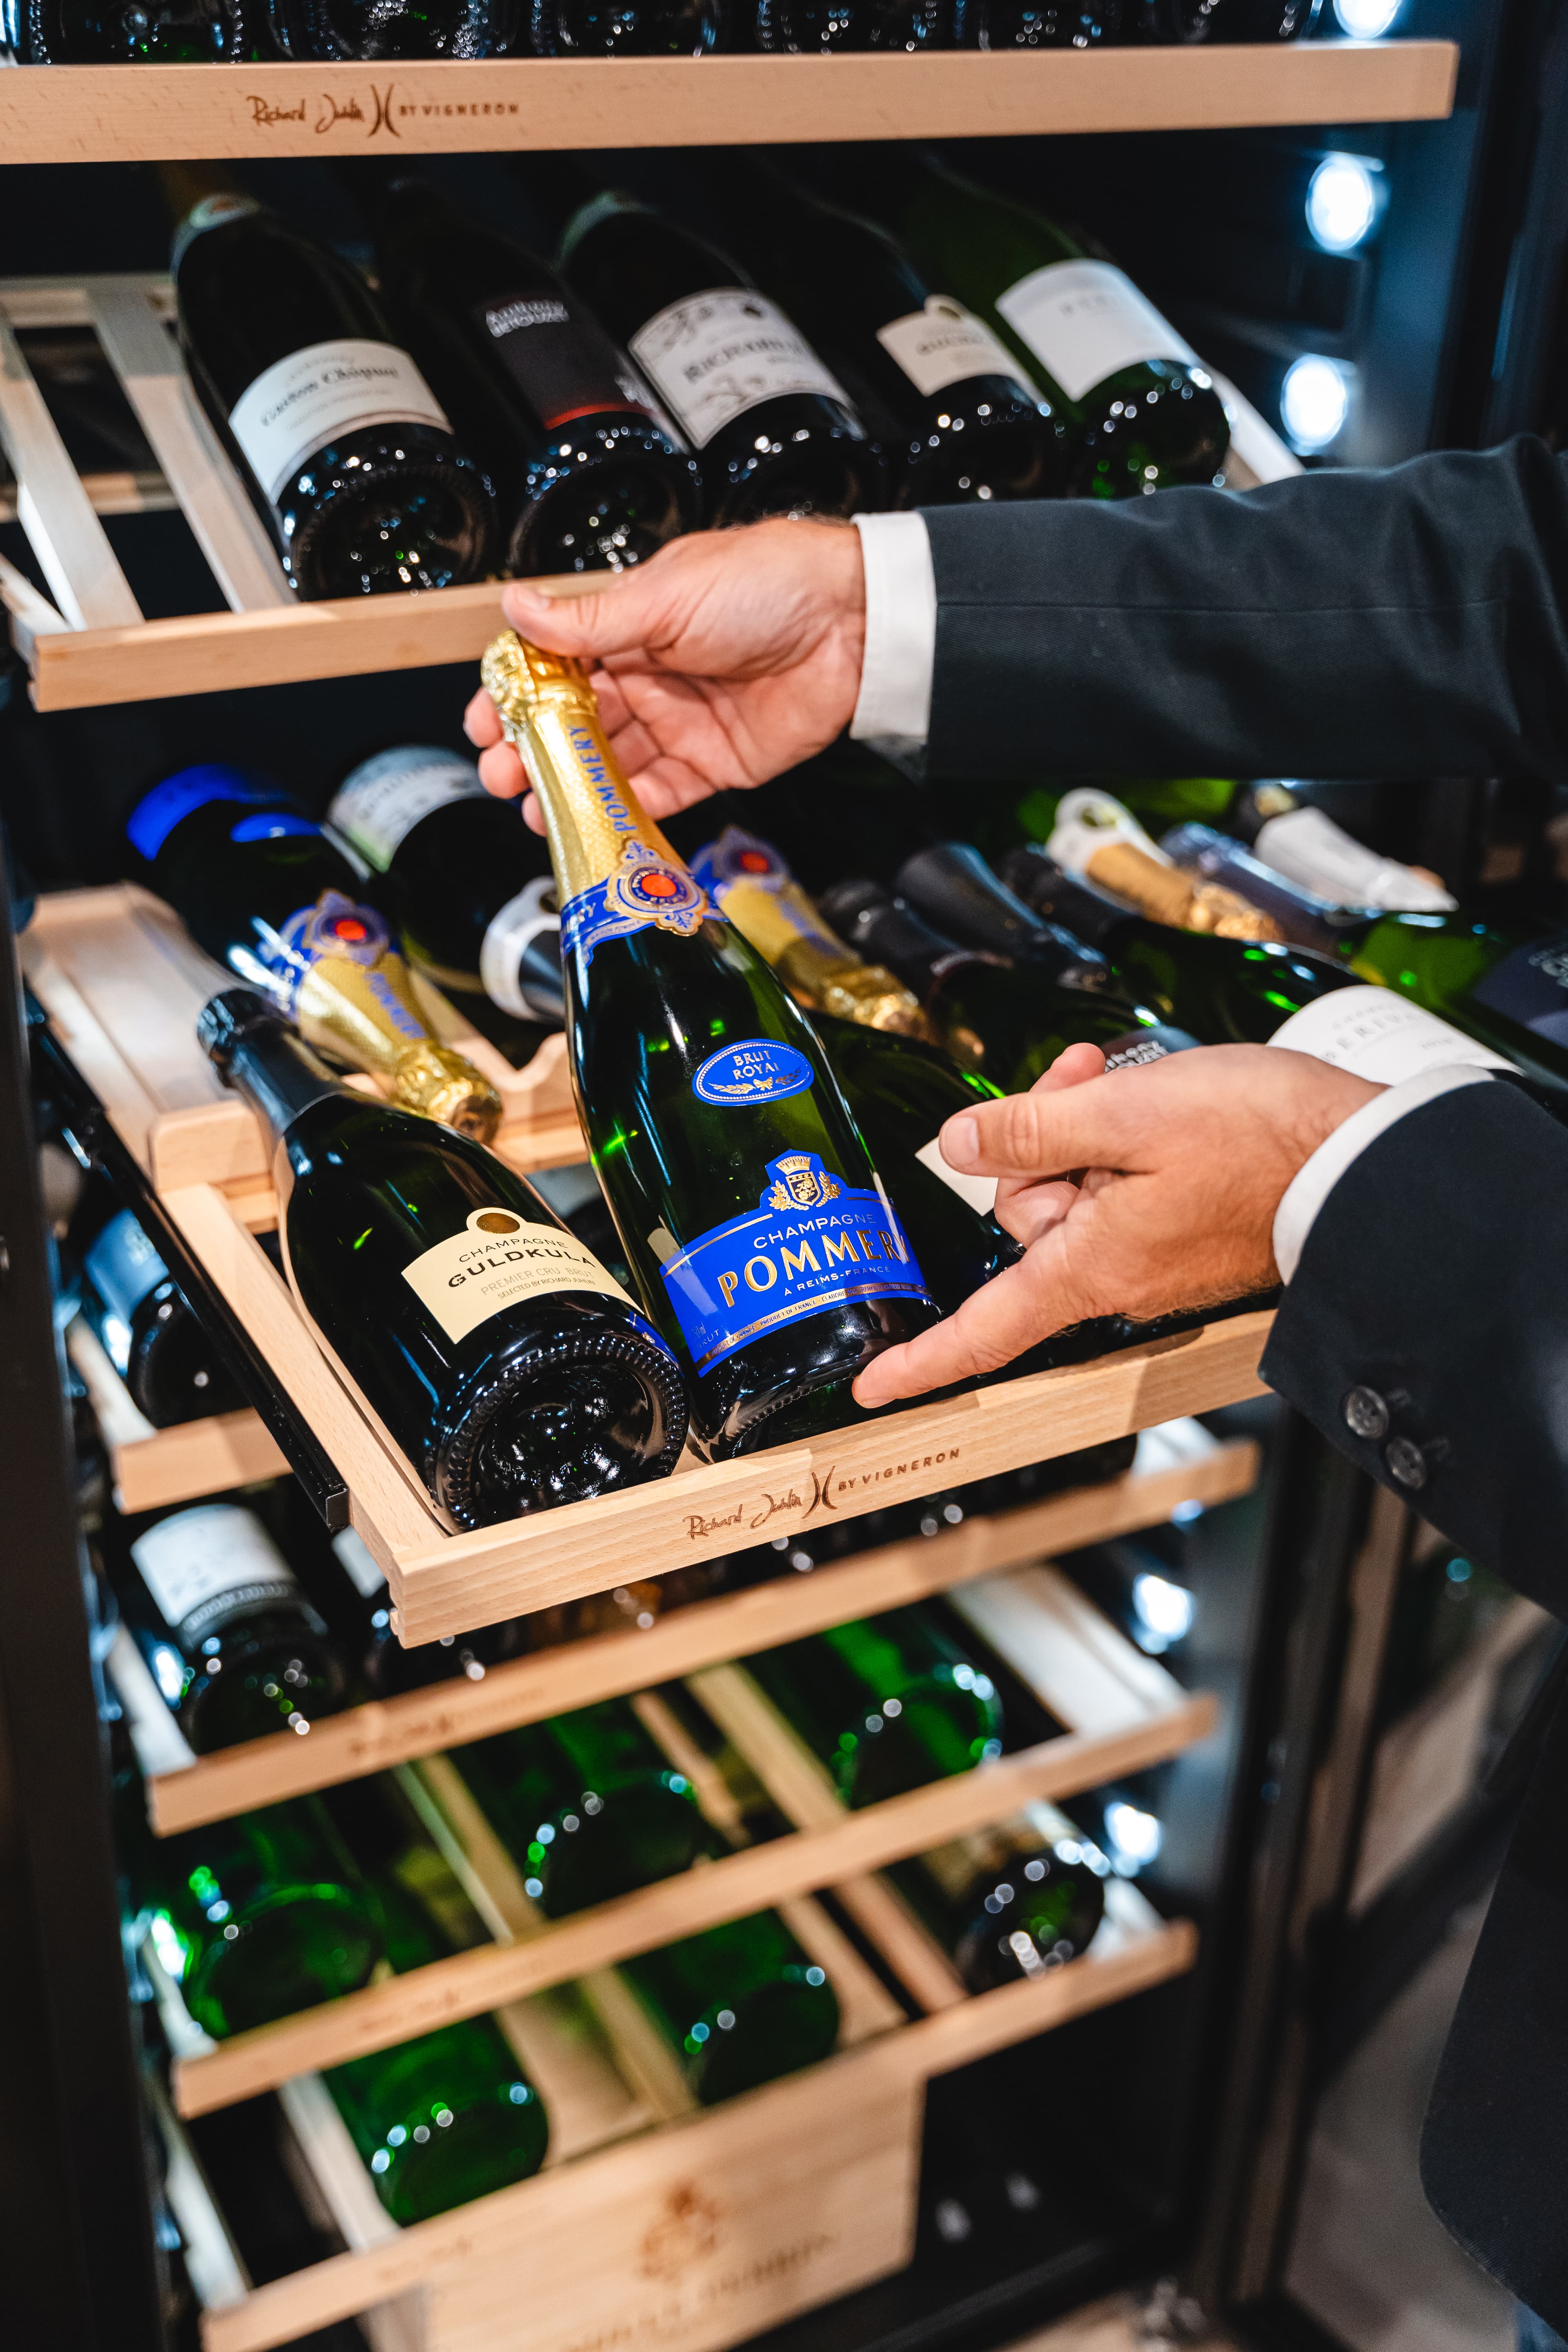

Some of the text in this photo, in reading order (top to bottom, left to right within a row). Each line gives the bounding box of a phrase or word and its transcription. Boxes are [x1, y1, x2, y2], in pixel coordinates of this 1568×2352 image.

[421, 103, 519, 117] VIGNERON
[567, 726, 637, 832] POMMERY
[733, 1050, 772, 1067] BRUT
[733, 1062, 782, 1080] ROYAL
[753, 1214, 877, 1249] CHAMPAGNE
[459, 1238, 568, 1263] CHAMPAGNE
[448, 1249, 597, 1287] GULDKULA
[481, 1267, 594, 1295] PREMIER CRU BRUT
[717, 1229, 910, 1308] POMMERY
[498, 1283, 531, 1299] SELECTED
[572, 1277, 596, 1285] JUHLIN
[760, 1311, 785, 1326] PRODUCT
[795, 1300, 817, 1311] FRANCE
[682, 1448, 959, 1540] Richard Juhlin BY VIGNERON
